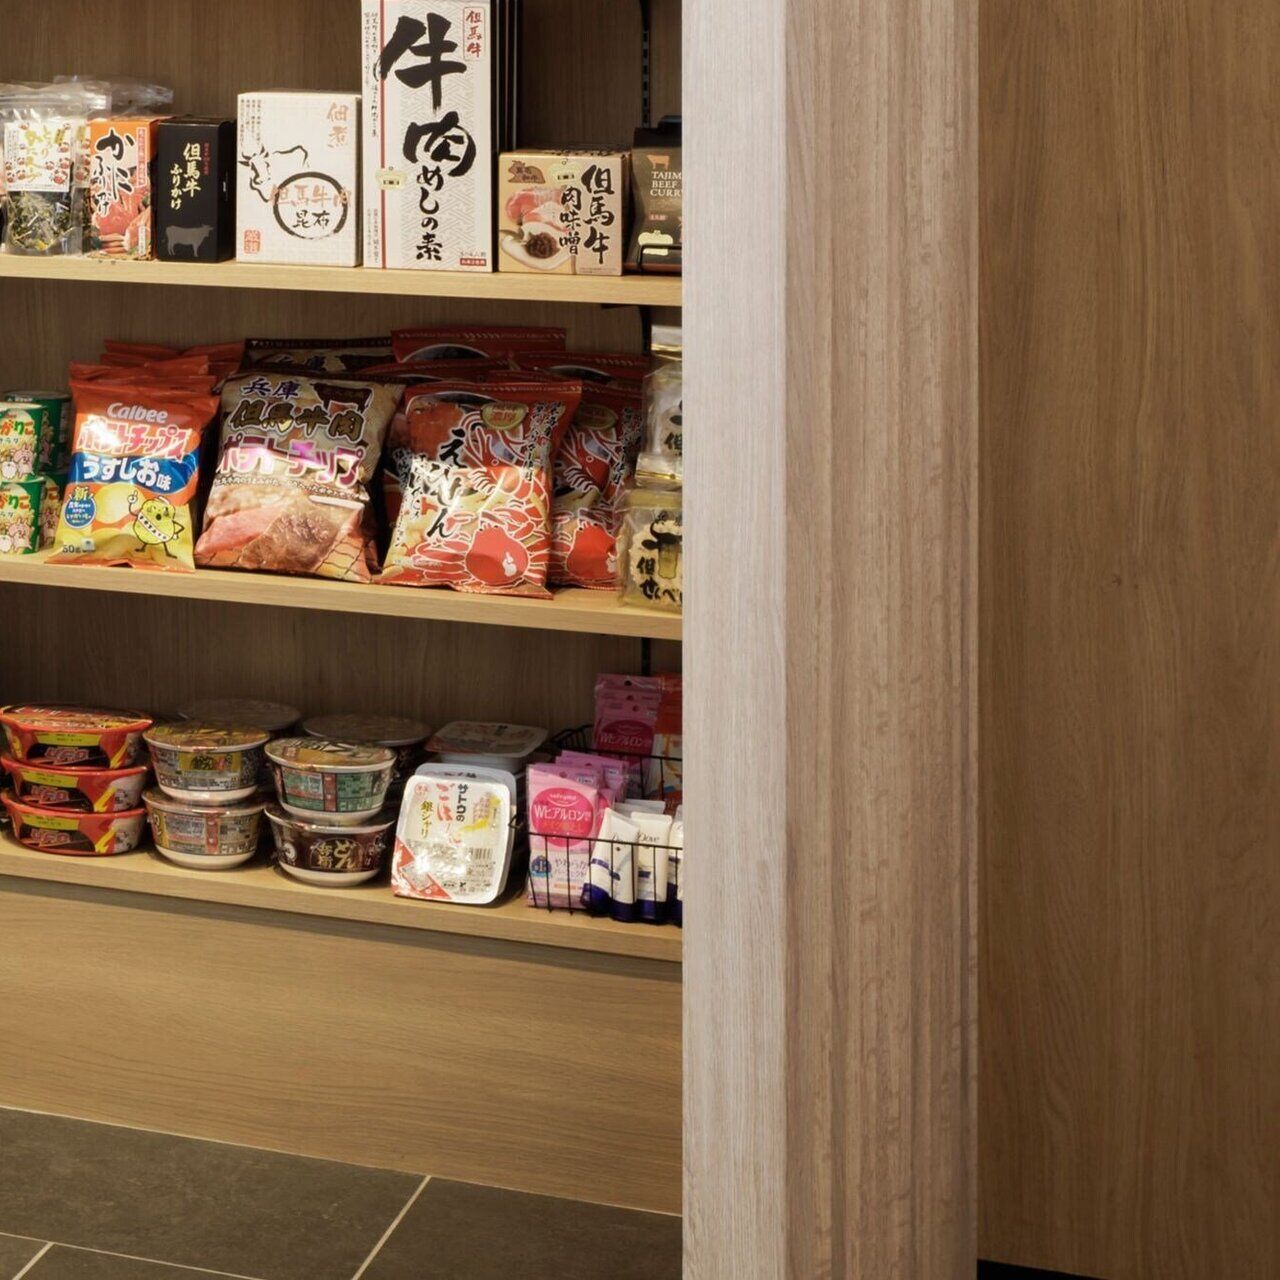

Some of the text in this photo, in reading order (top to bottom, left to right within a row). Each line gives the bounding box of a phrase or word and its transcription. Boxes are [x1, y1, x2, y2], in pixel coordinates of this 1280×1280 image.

[466, 9, 482, 58] 但馬牛
[170, 163, 183, 211] ふりかけ
[182, 142, 202, 198] 但馬牛
[652, 180, 678, 188] BEEF
[650, 188, 682, 197] CURR
[293, 210, 330, 230] 昆布
[559, 186, 583, 255] 肉味噌
[581, 164, 615, 265] 但馬牛
[243, 377, 300, 400] 兵庫
[107, 402, 168, 422] Calbee
[82, 457, 173, 491] うすしお味
